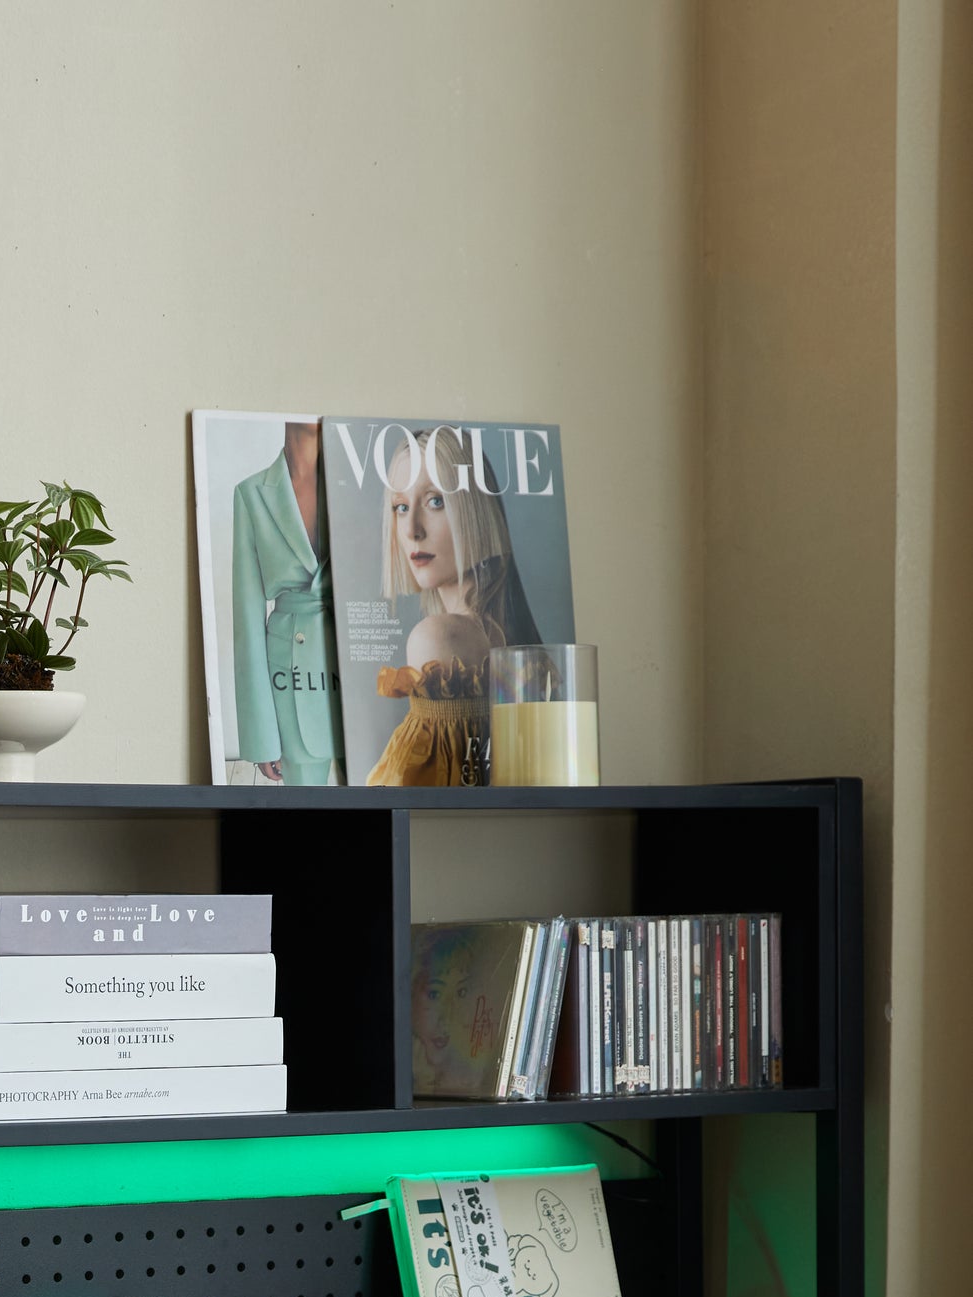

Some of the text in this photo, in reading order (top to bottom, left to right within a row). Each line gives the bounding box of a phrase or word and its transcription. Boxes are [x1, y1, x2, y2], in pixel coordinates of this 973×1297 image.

[330, 422, 554, 496] VOGUE
[20, 904, 88, 923] Love
[150, 904, 216, 922] Love
[93, 924, 144, 942] and
[65, 975, 206, 998] Something you like
[77, 1034, 175, 1045] STILETTO BOOK
[82, 1090, 103, 1100] Arna
[106, 1090, 122, 1099] Bee
[124, 1088, 170, 1099] arnabe.com
[540, 1195, 567, 1250] vegetable
